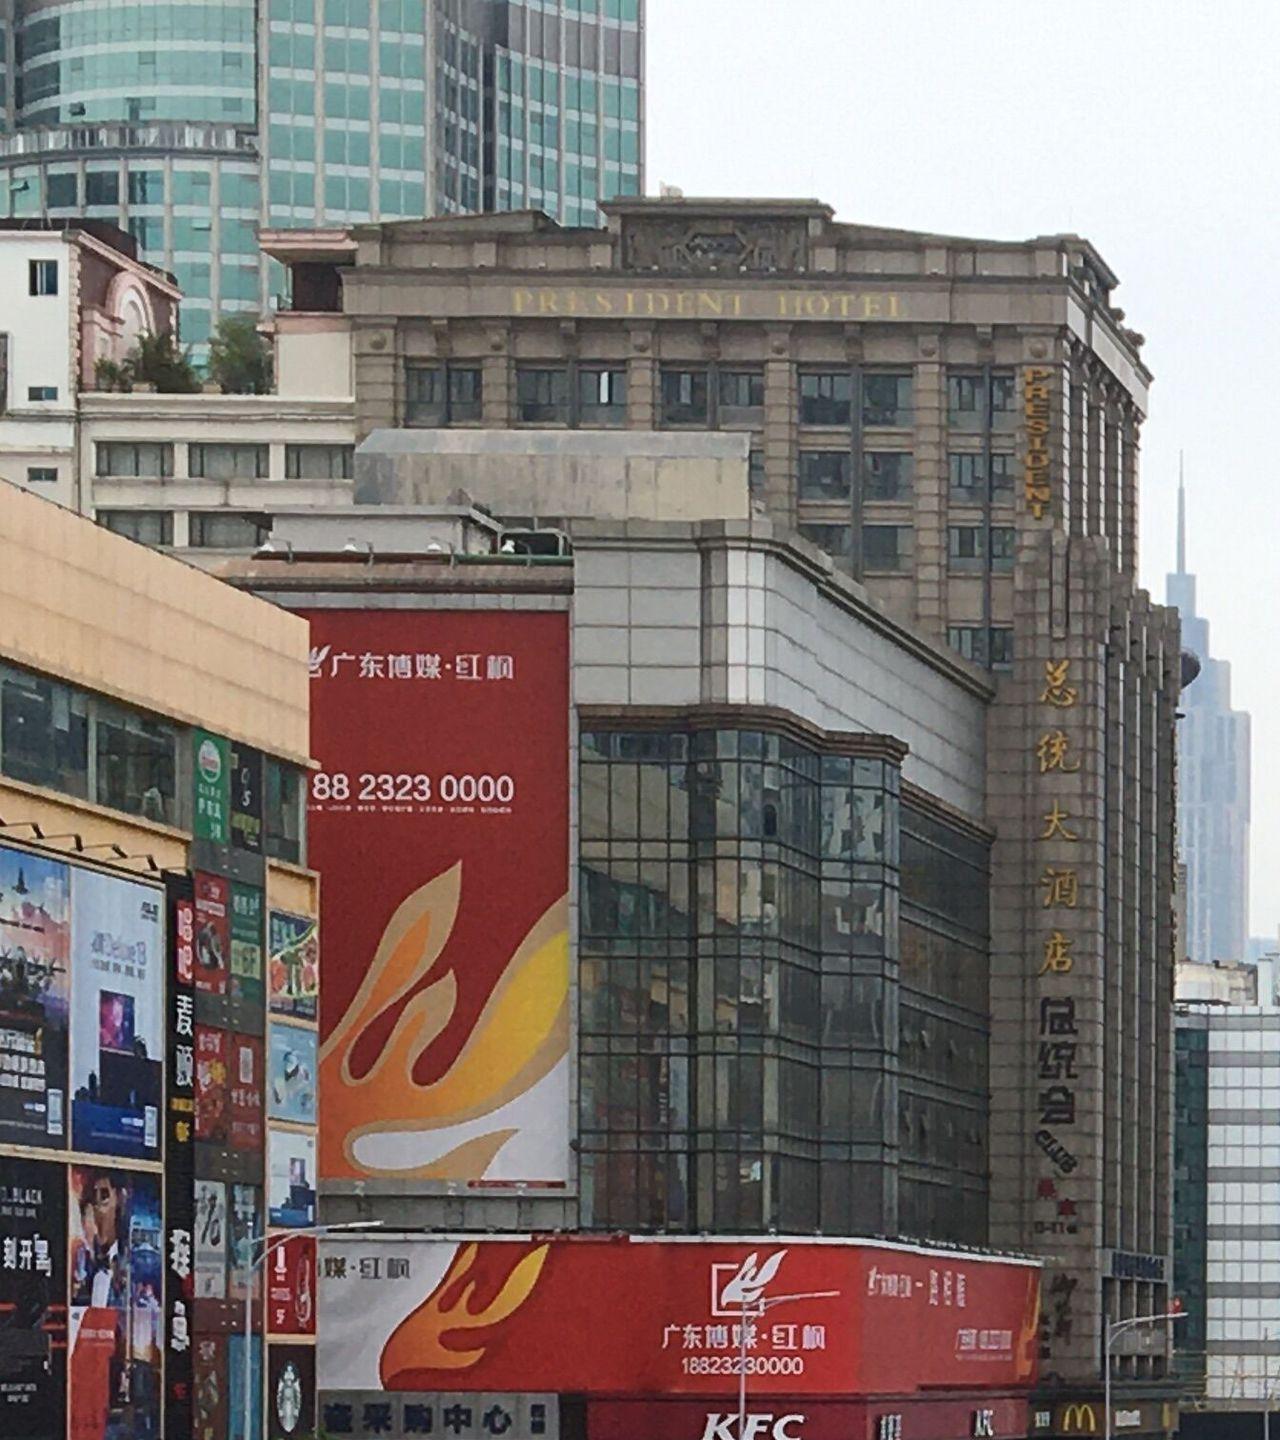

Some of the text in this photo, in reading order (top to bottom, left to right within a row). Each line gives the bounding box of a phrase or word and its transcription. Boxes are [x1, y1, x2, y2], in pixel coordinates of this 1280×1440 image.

[512, 290, 905, 319] PRESIDENT HOTEL
[1024, 369, 1050, 520] PRESIDENT
[358, 773, 431, 801] 2323
[440, 774, 515, 802] 0000
[1036, 658, 1081, 978] 总统大酒店
